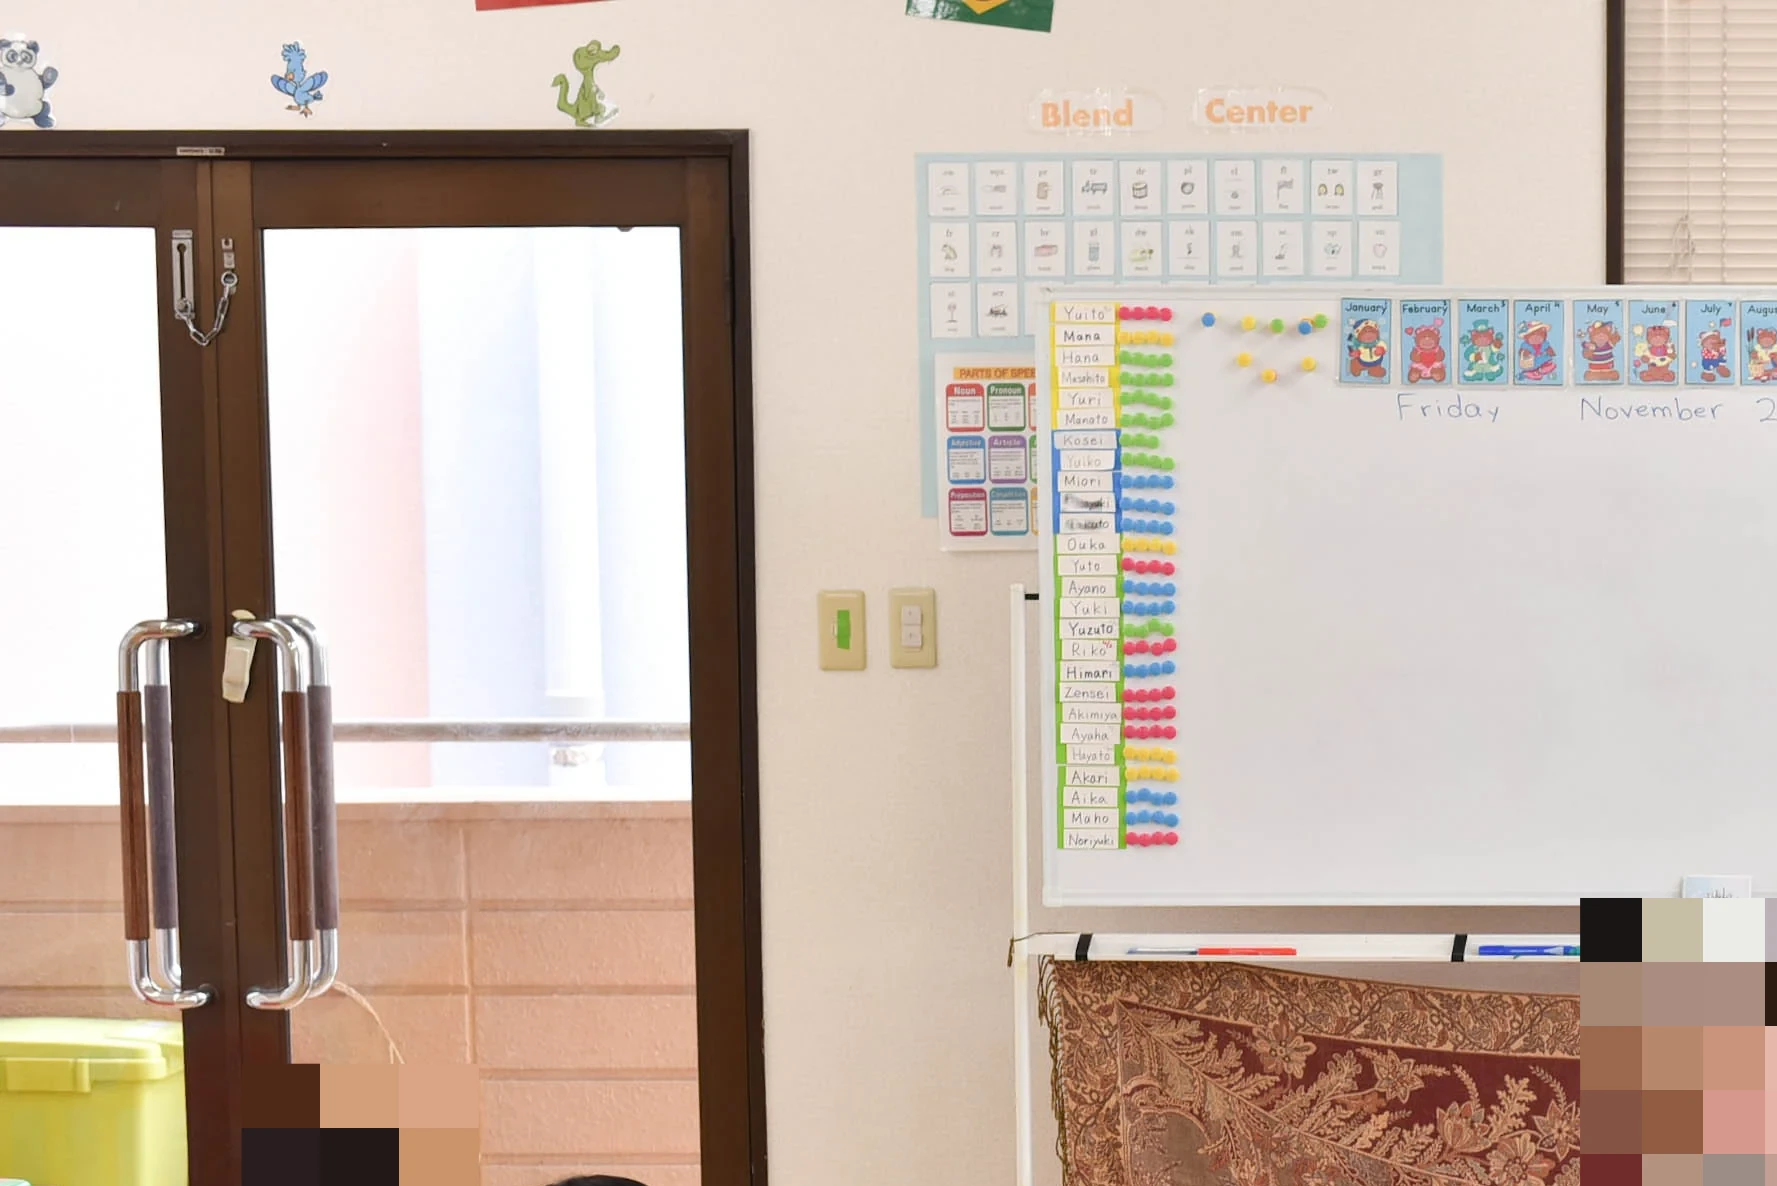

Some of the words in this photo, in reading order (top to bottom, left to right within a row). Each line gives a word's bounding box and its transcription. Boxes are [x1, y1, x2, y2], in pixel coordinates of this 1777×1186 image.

[1041, 99, 1133, 127] Blend
[1205, 98, 1313, 124] Center
[1345, 303, 1387, 315] January
[1402, 303, 1448, 316] February
[1467, 303, 1500, 313] March
[1525, 303, 1550, 316] April
[1587, 304, 1608, 315] May
[1642, 305, 1666, 314] June
[1700, 304, 1721, 315] July
[1063, 330, 1100, 342] Mana
[1062, 350, 1099, 366] Hana
[954, 386, 976, 395] Noun
[1070, 392, 1101, 405] Yuri
[1397, 392, 1500, 422] Friday
[1580, 394, 1724, 422] November
[1065, 412, 1108, 425] Manato
[1063, 435, 1103, 447] Kosei
[1064, 475, 1100, 490] Miori
[1067, 538, 1105, 551] Ouka
[1073, 560, 1100, 573] Yuto
[1070, 600, 1107, 615] Yuki
[1072, 642, 1106, 656] Riko
[1066, 666, 1112, 679] Himari
[1064, 687, 1109, 699] Zensei
[1068, 707, 1117, 722] Akimiya
[1071, 727, 1109, 743] Ayaha
[1072, 748, 1110, 762] Hayato
[1071, 770, 1108, 784] Akari
[1071, 791, 1107, 804] Aika
[1071, 813, 1109, 824] Maho
[1068, 832, 1114, 848] Noriyuki
